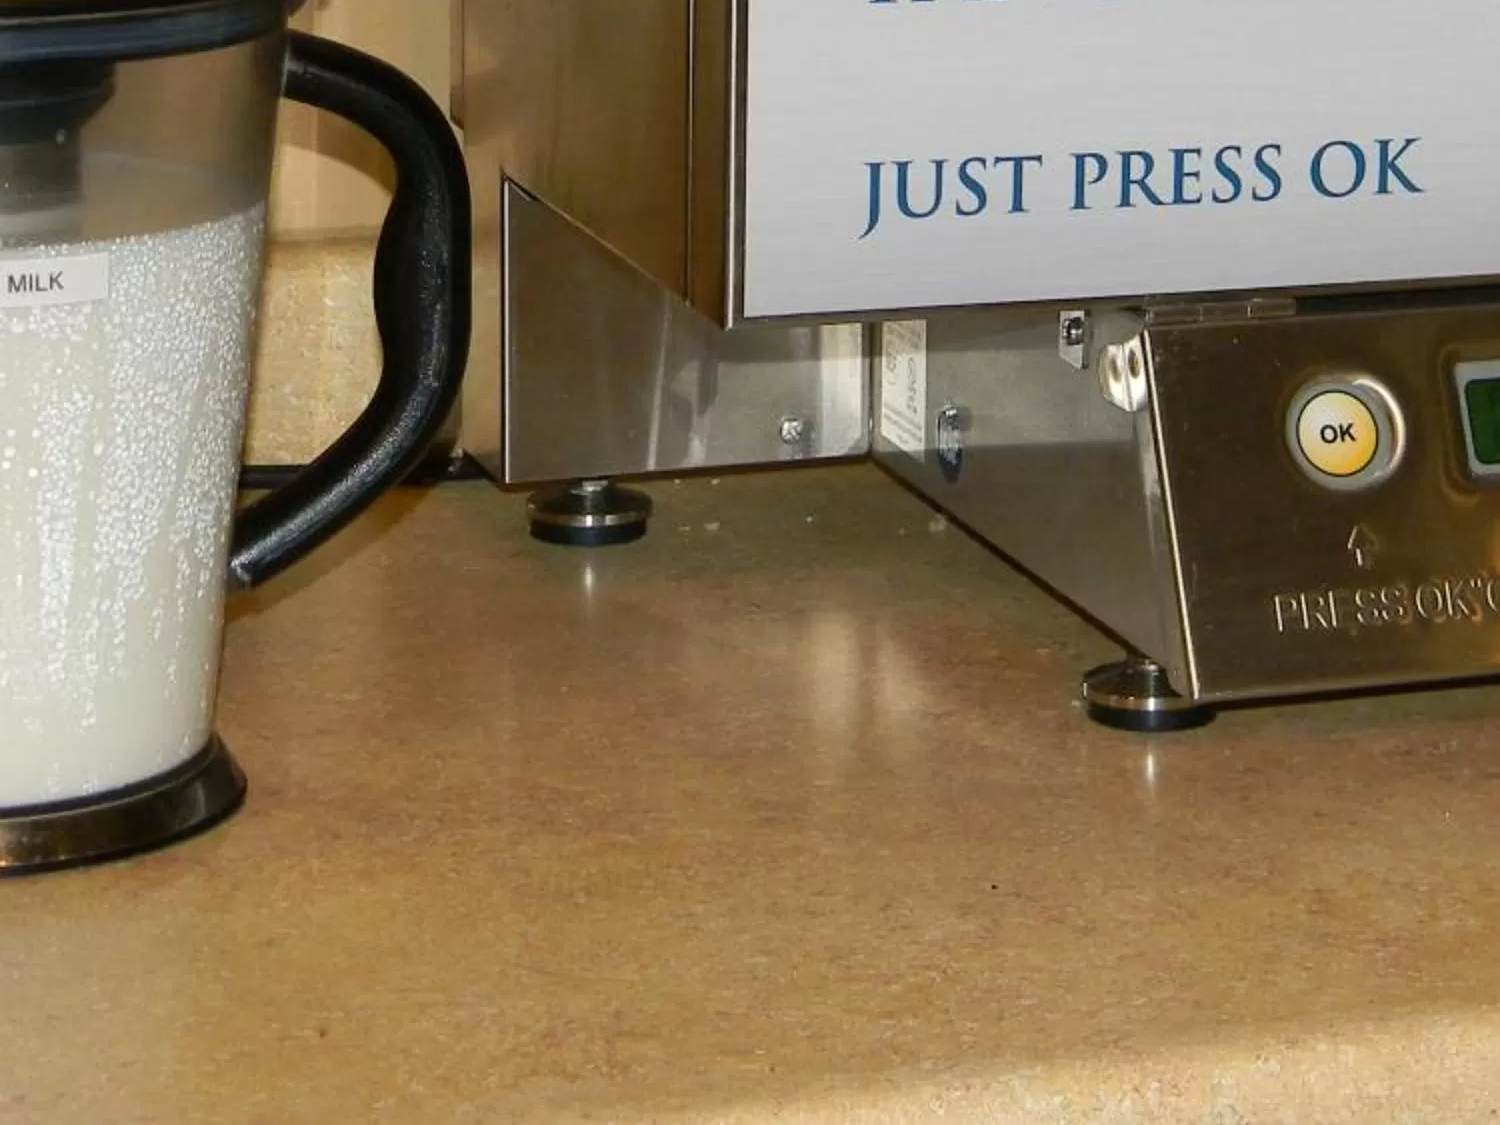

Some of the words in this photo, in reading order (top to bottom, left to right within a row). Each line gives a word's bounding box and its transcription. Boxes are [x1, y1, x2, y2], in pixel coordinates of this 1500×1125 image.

[860, 155, 1042, 238] JUST
[1071, 144, 1281, 209] PRESS
[1310, 139, 1423, 197] OK
[7, 271, 64, 293] MILK
[1320, 423, 1356, 444] OK
[1273, 587, 1410, 633] PRESS
